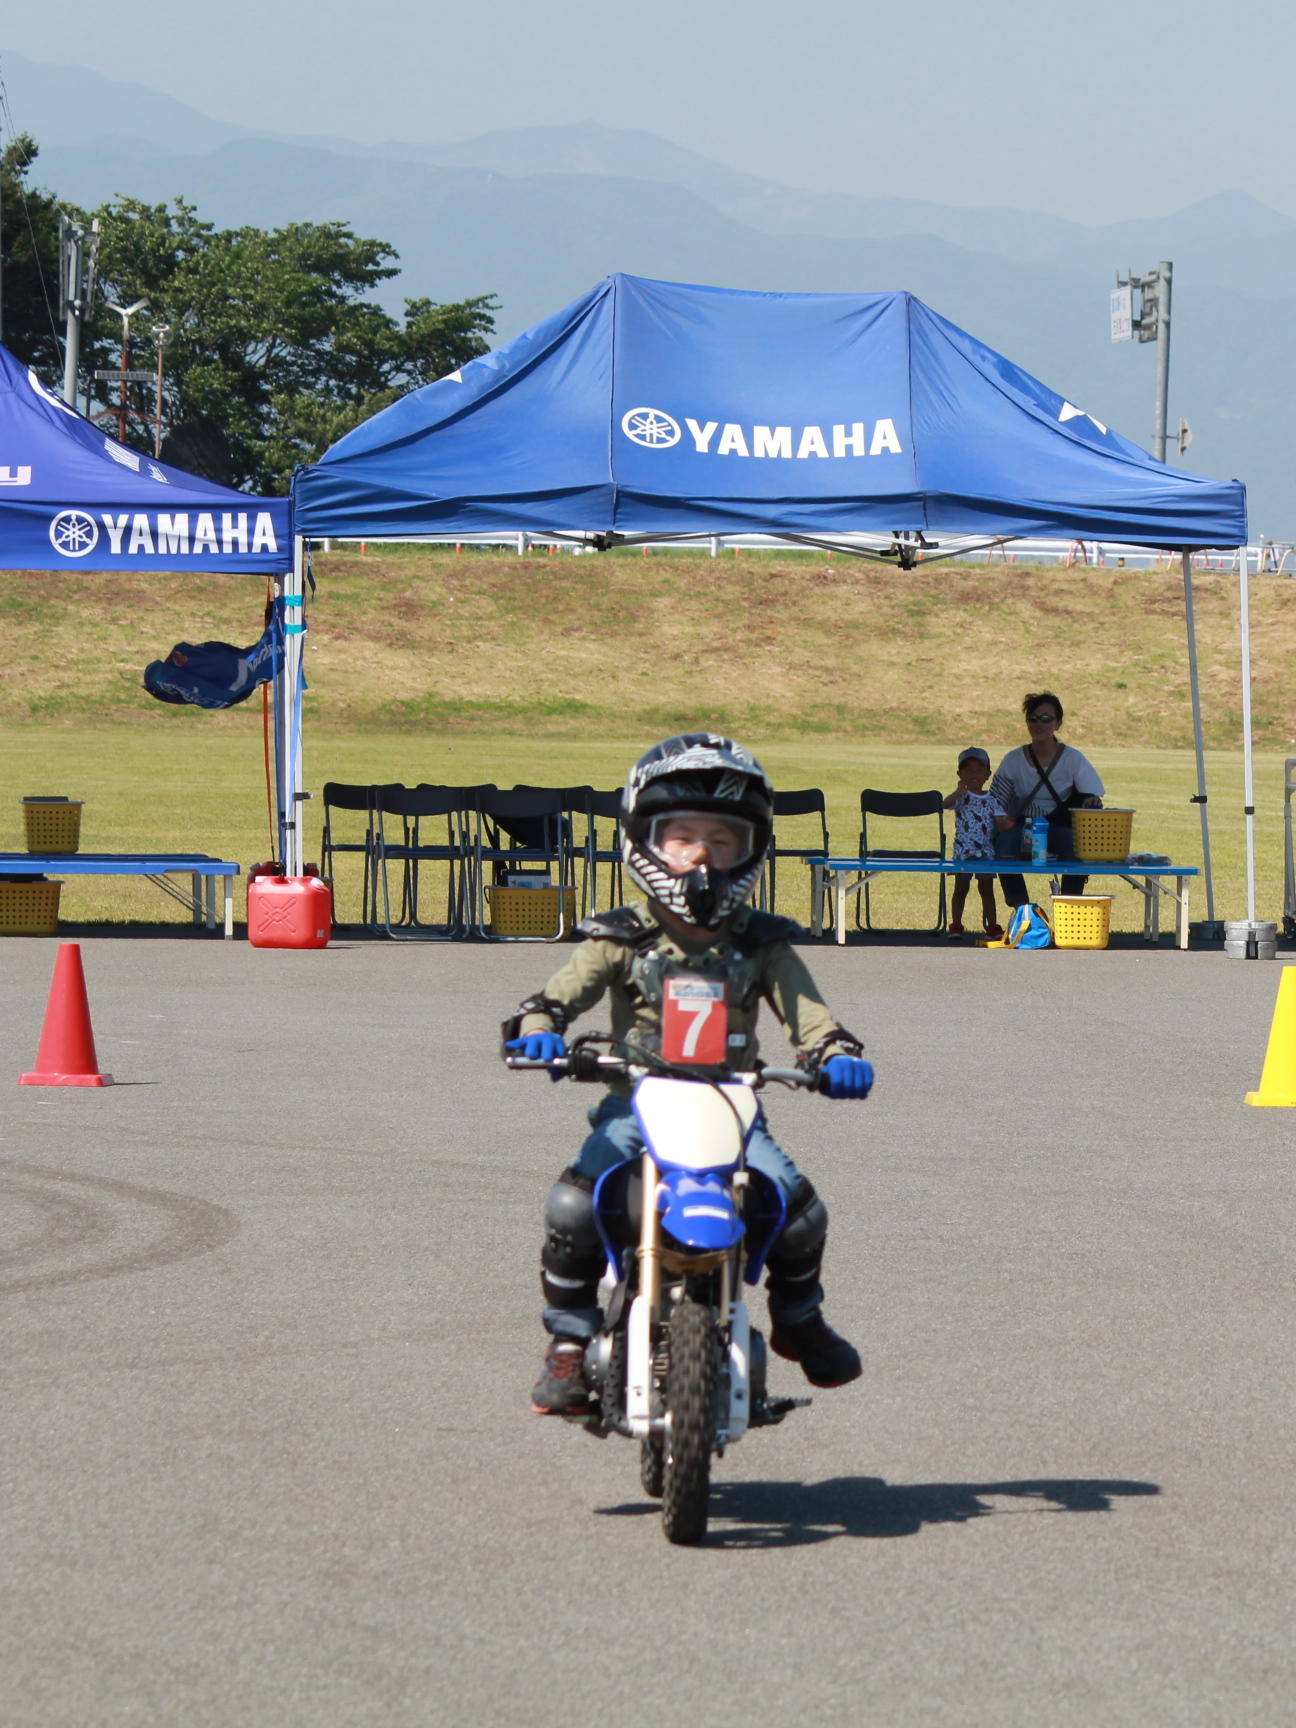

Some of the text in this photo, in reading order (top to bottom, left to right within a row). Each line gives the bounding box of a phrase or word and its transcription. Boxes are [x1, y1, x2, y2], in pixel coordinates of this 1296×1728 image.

[685, 418, 902, 458] YAMAHA
[101, 511, 279, 555] YAMAHA
[677, 1000, 713, 1057] 7
